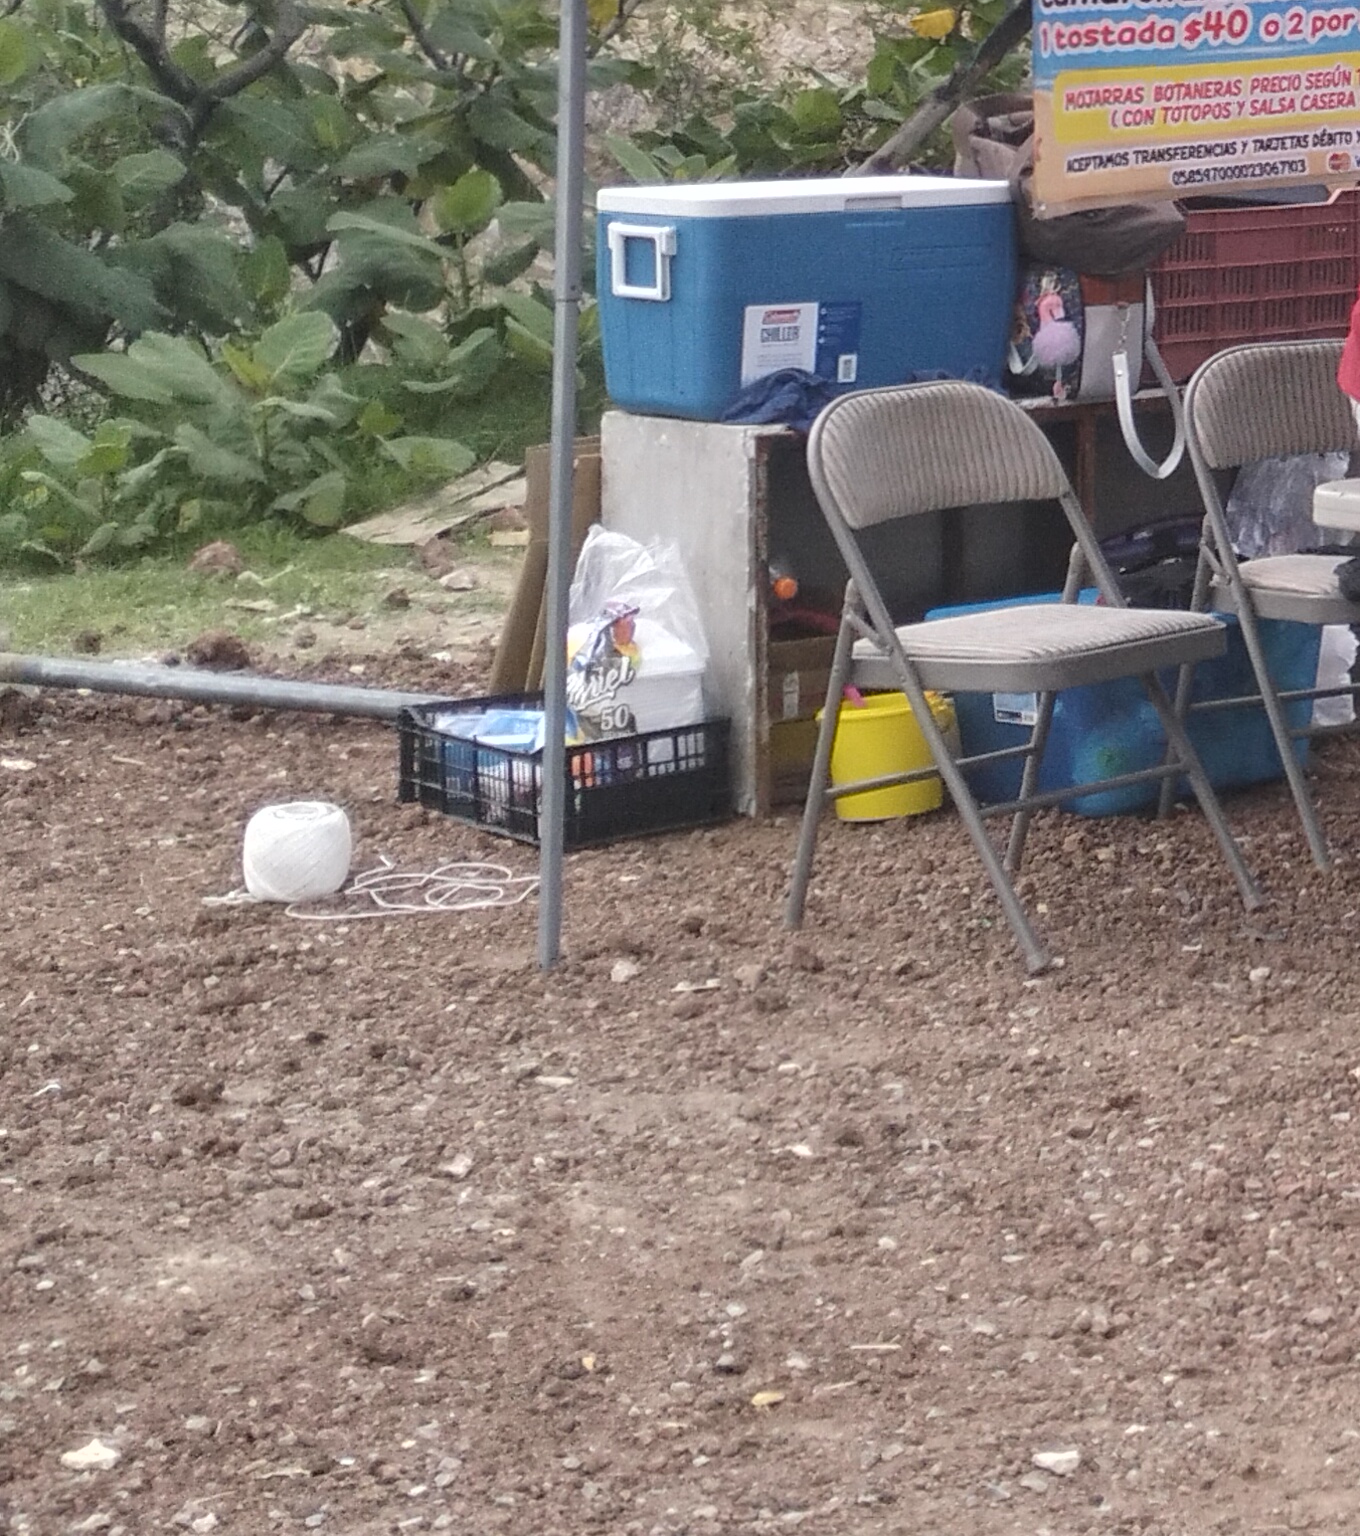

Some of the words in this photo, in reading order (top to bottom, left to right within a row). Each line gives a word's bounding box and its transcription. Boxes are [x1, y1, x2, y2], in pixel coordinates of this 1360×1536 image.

[1054, 20, 1177, 51] tostada
[1183, 8, 1250, 44] $40
[1263, 19, 1280, 37] o
[1287, 12, 1305, 37] 2
[1310, 13, 1356, 38] por
[1064, 86, 1145, 112] MOJARRAS
[1153, 78, 1243, 103] BOTANERAS
[1250, 73, 1301, 95] PRECIO
[1304, 64, 1352, 91] SEGÚN
[1121, 107, 1156, 128] CON
[1160, 101, 1233, 125] TOTOPOS
[1235, 100, 1246, 116] Y
[1249, 96, 1296, 117] SALSA
[1300, 90, 1356, 112] CASERA
[1066, 151, 1130, 174] ACEPTAMOS
[1132, 140, 1238, 165] TRANSFERENCIAS
[1251, 133, 1310, 154] TARJETAS
[600, 703, 630, 732] 50
